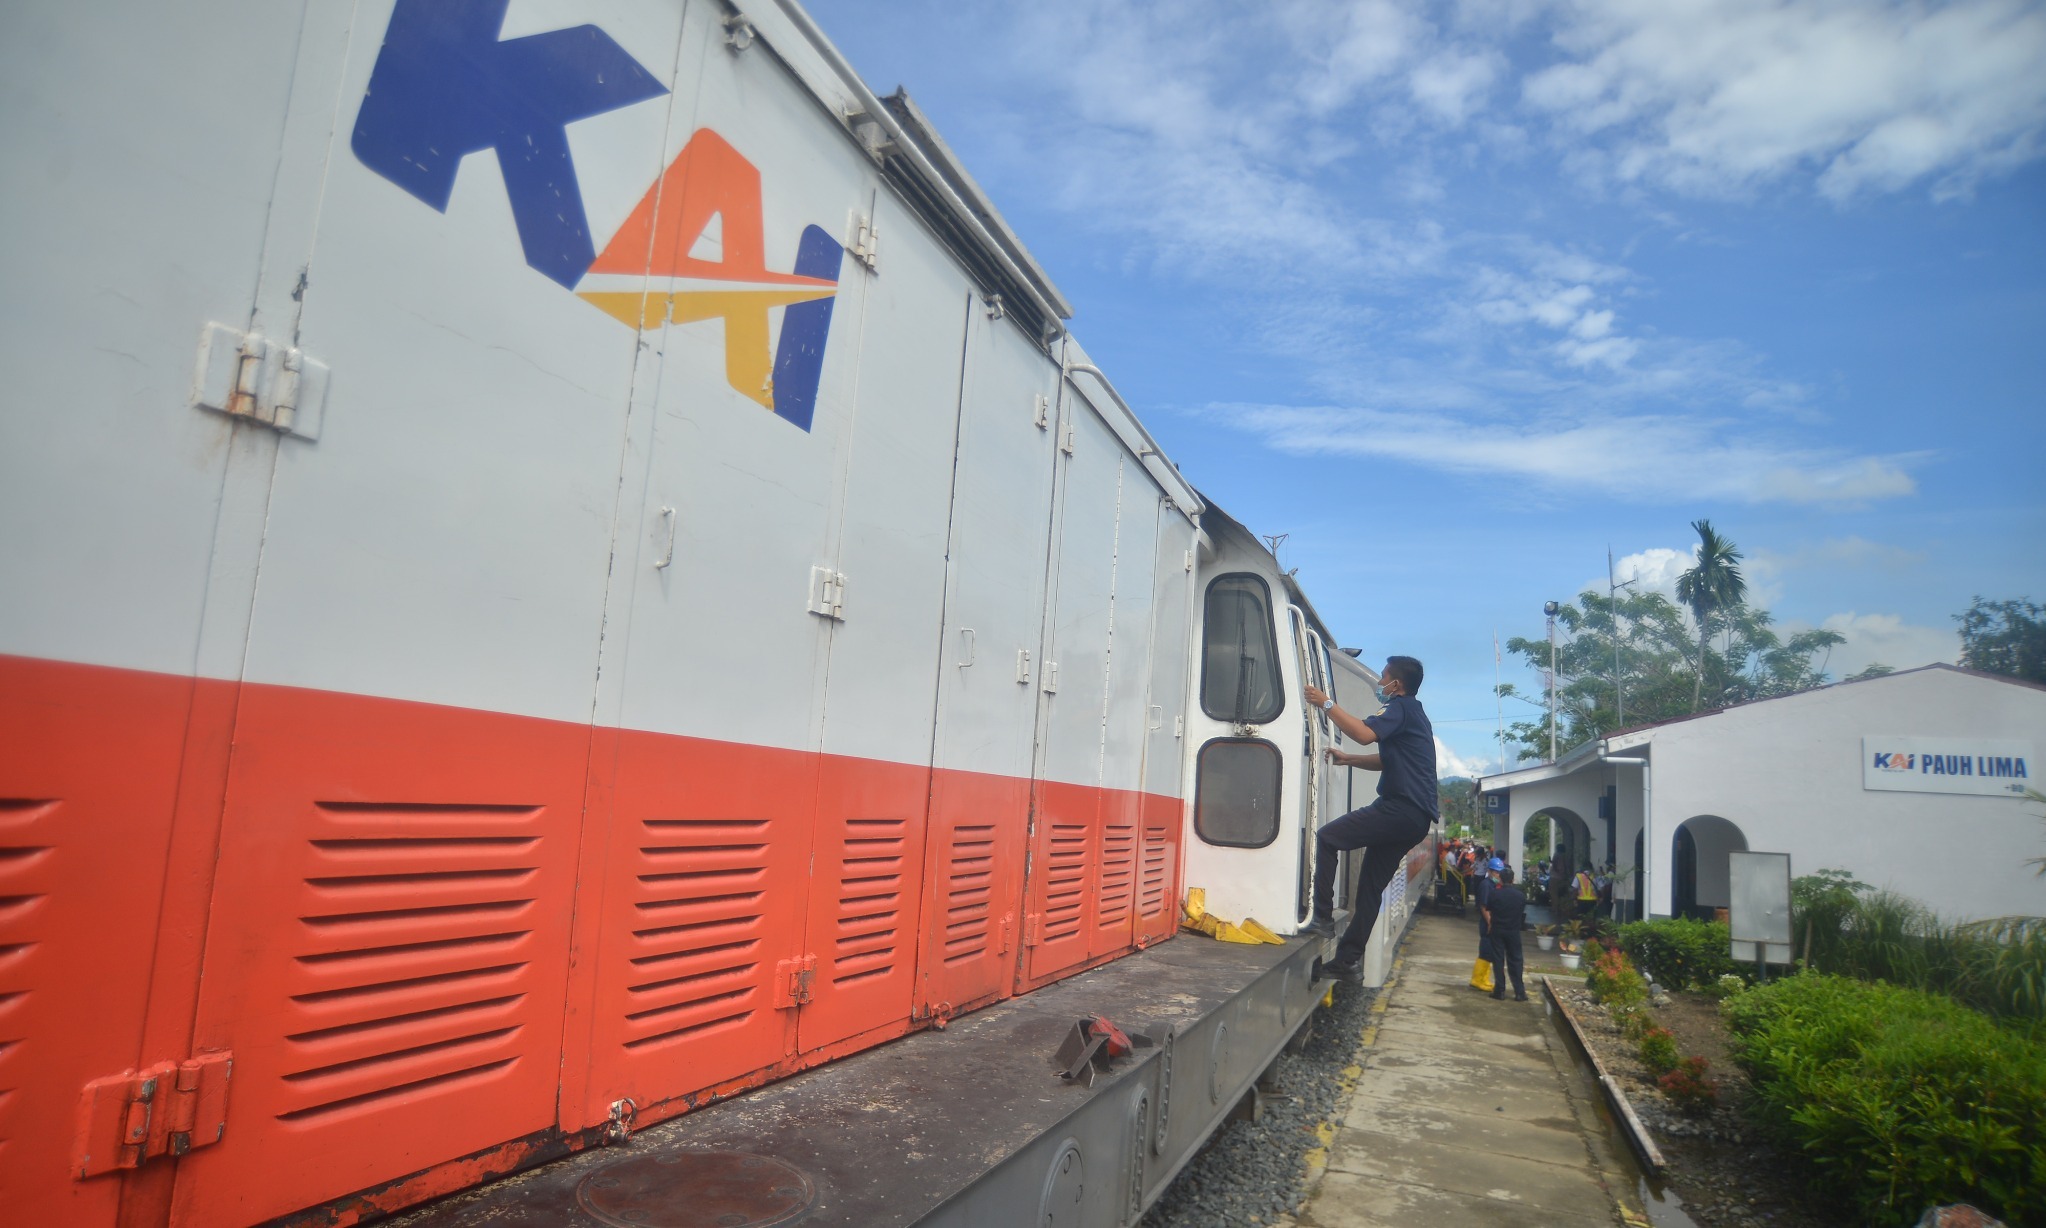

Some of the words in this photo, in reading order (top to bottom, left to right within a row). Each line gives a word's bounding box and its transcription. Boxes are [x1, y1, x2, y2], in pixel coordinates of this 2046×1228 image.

[351, 0, 844, 433] KAI
[1873, 752, 1915, 770] KAI
[1921, 754, 1972, 776] PAUH
[1978, 756, 2027, 778] LIMA
